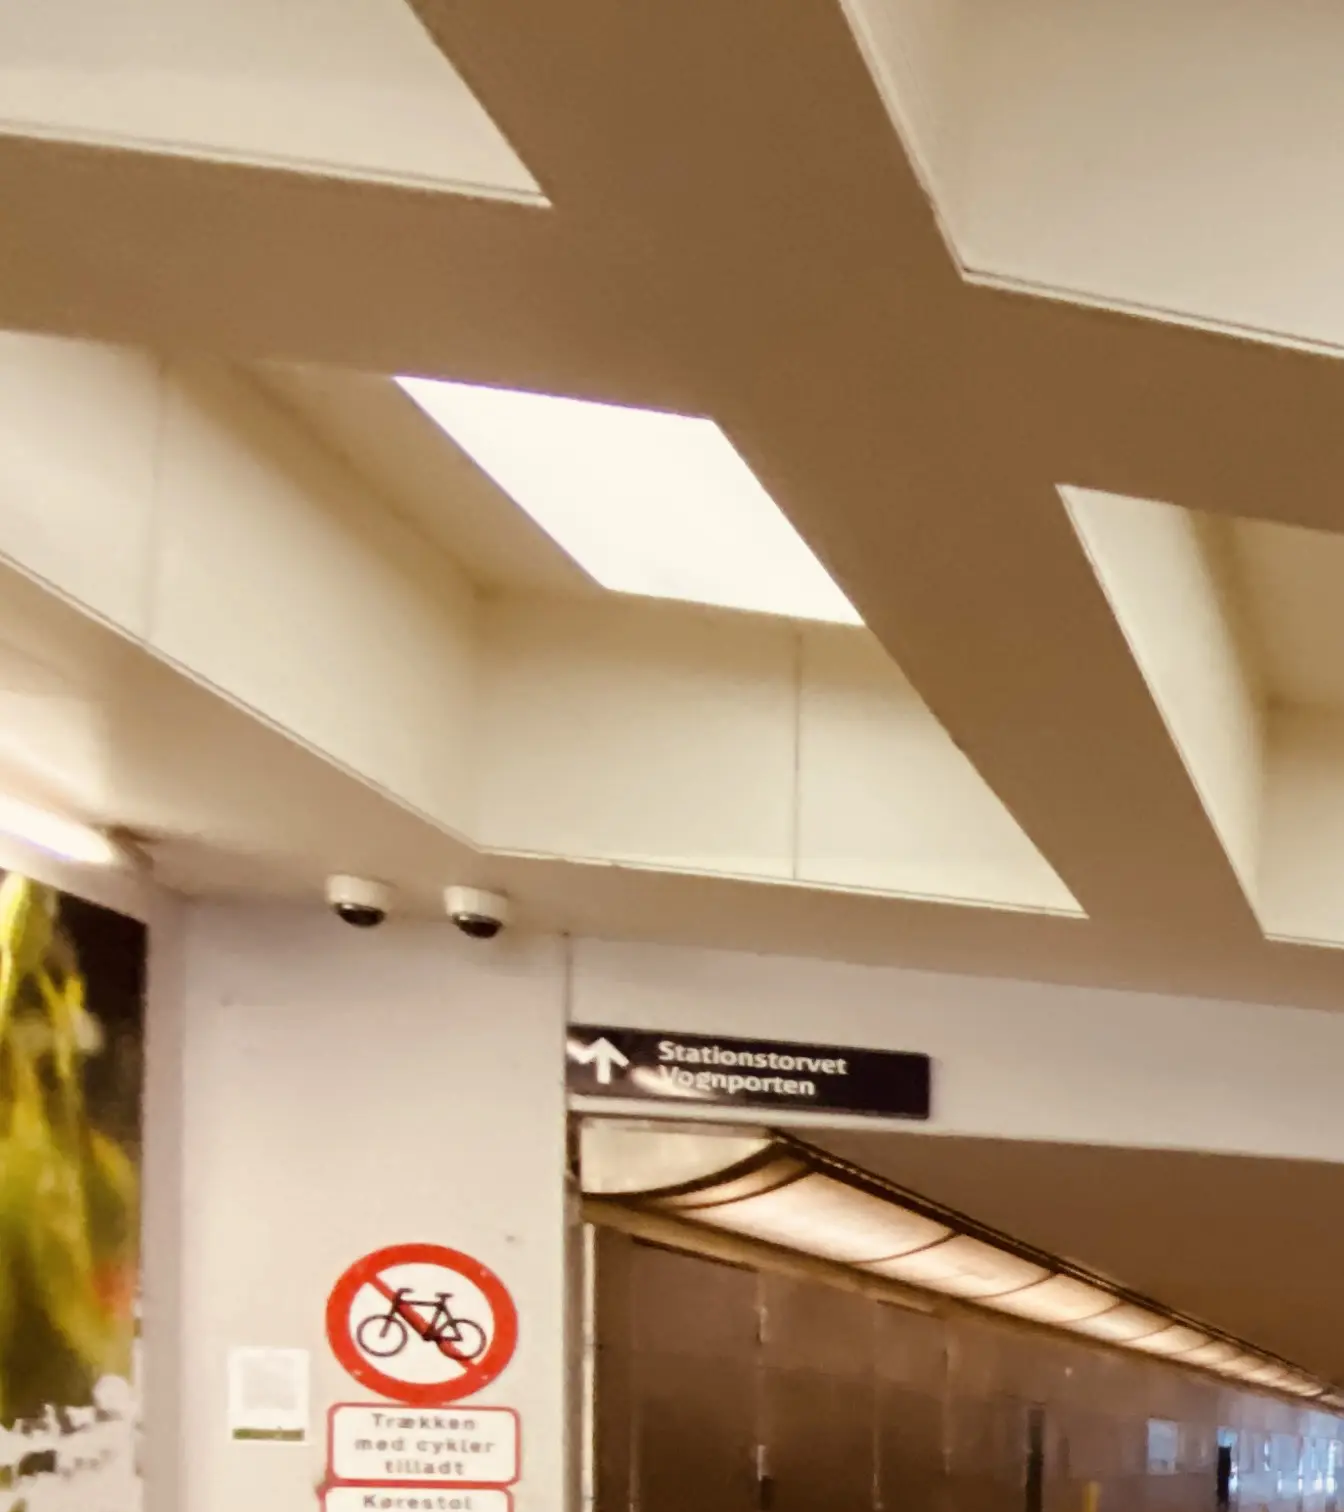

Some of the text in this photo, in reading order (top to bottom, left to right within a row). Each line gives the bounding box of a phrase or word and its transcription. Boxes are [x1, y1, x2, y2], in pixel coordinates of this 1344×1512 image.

[657, 1040, 848, 1075] Stationstorvet
[658, 1064, 816, 1096] Vognporten
[372, 1412, 476, 1430] Trækken
[355, 1438, 495, 1455] med cykler
[385, 1459, 465, 1475] tilladt
[363, 1495, 472, 1510] Kørestol
